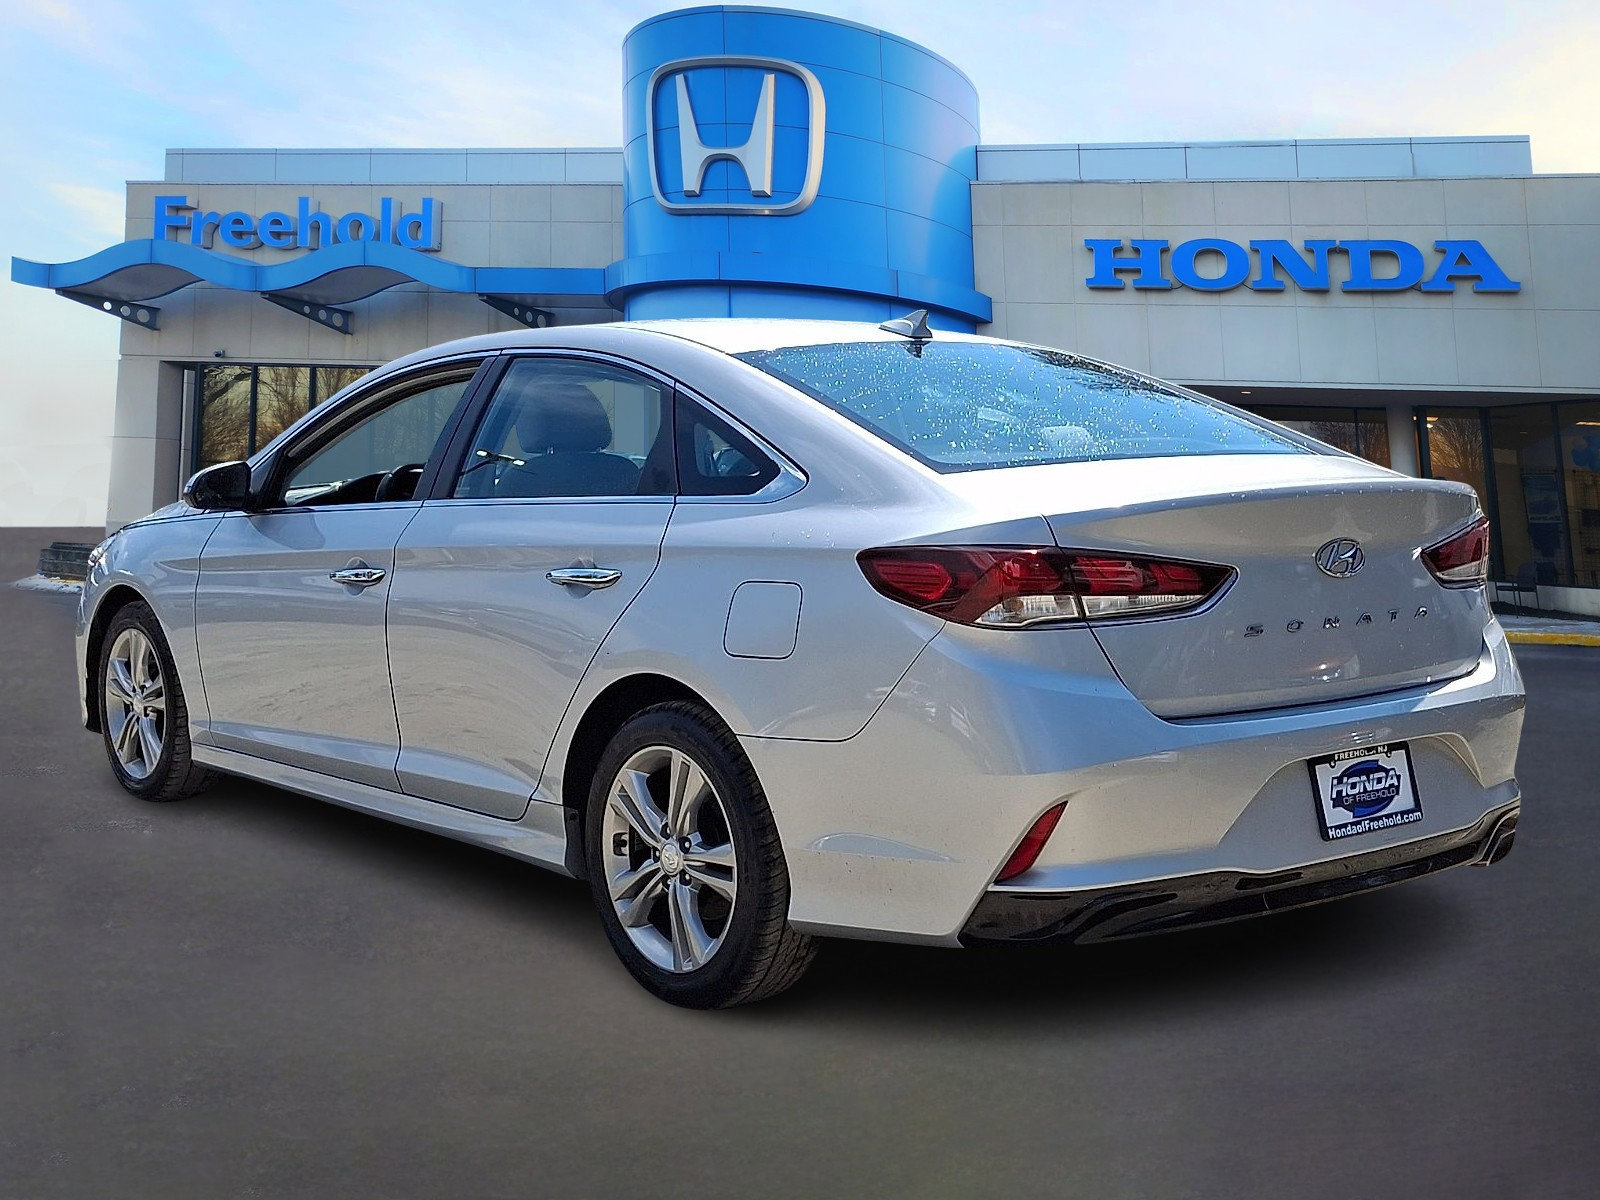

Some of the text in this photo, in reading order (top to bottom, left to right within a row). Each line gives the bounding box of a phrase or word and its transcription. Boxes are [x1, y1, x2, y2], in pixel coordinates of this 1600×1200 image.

[154, 195, 440, 250] Freehold
[1084, 238, 1521, 294] HONDA
[1244, 605, 1428, 638] SONATA
[1377, 745, 1388, 754] NJ
[1332, 770, 1399, 799] HONDA
[1343, 788, 1397, 805] OF FREEHOLD
[1328, 811, 1422, 839] HondaofFreehold.com
